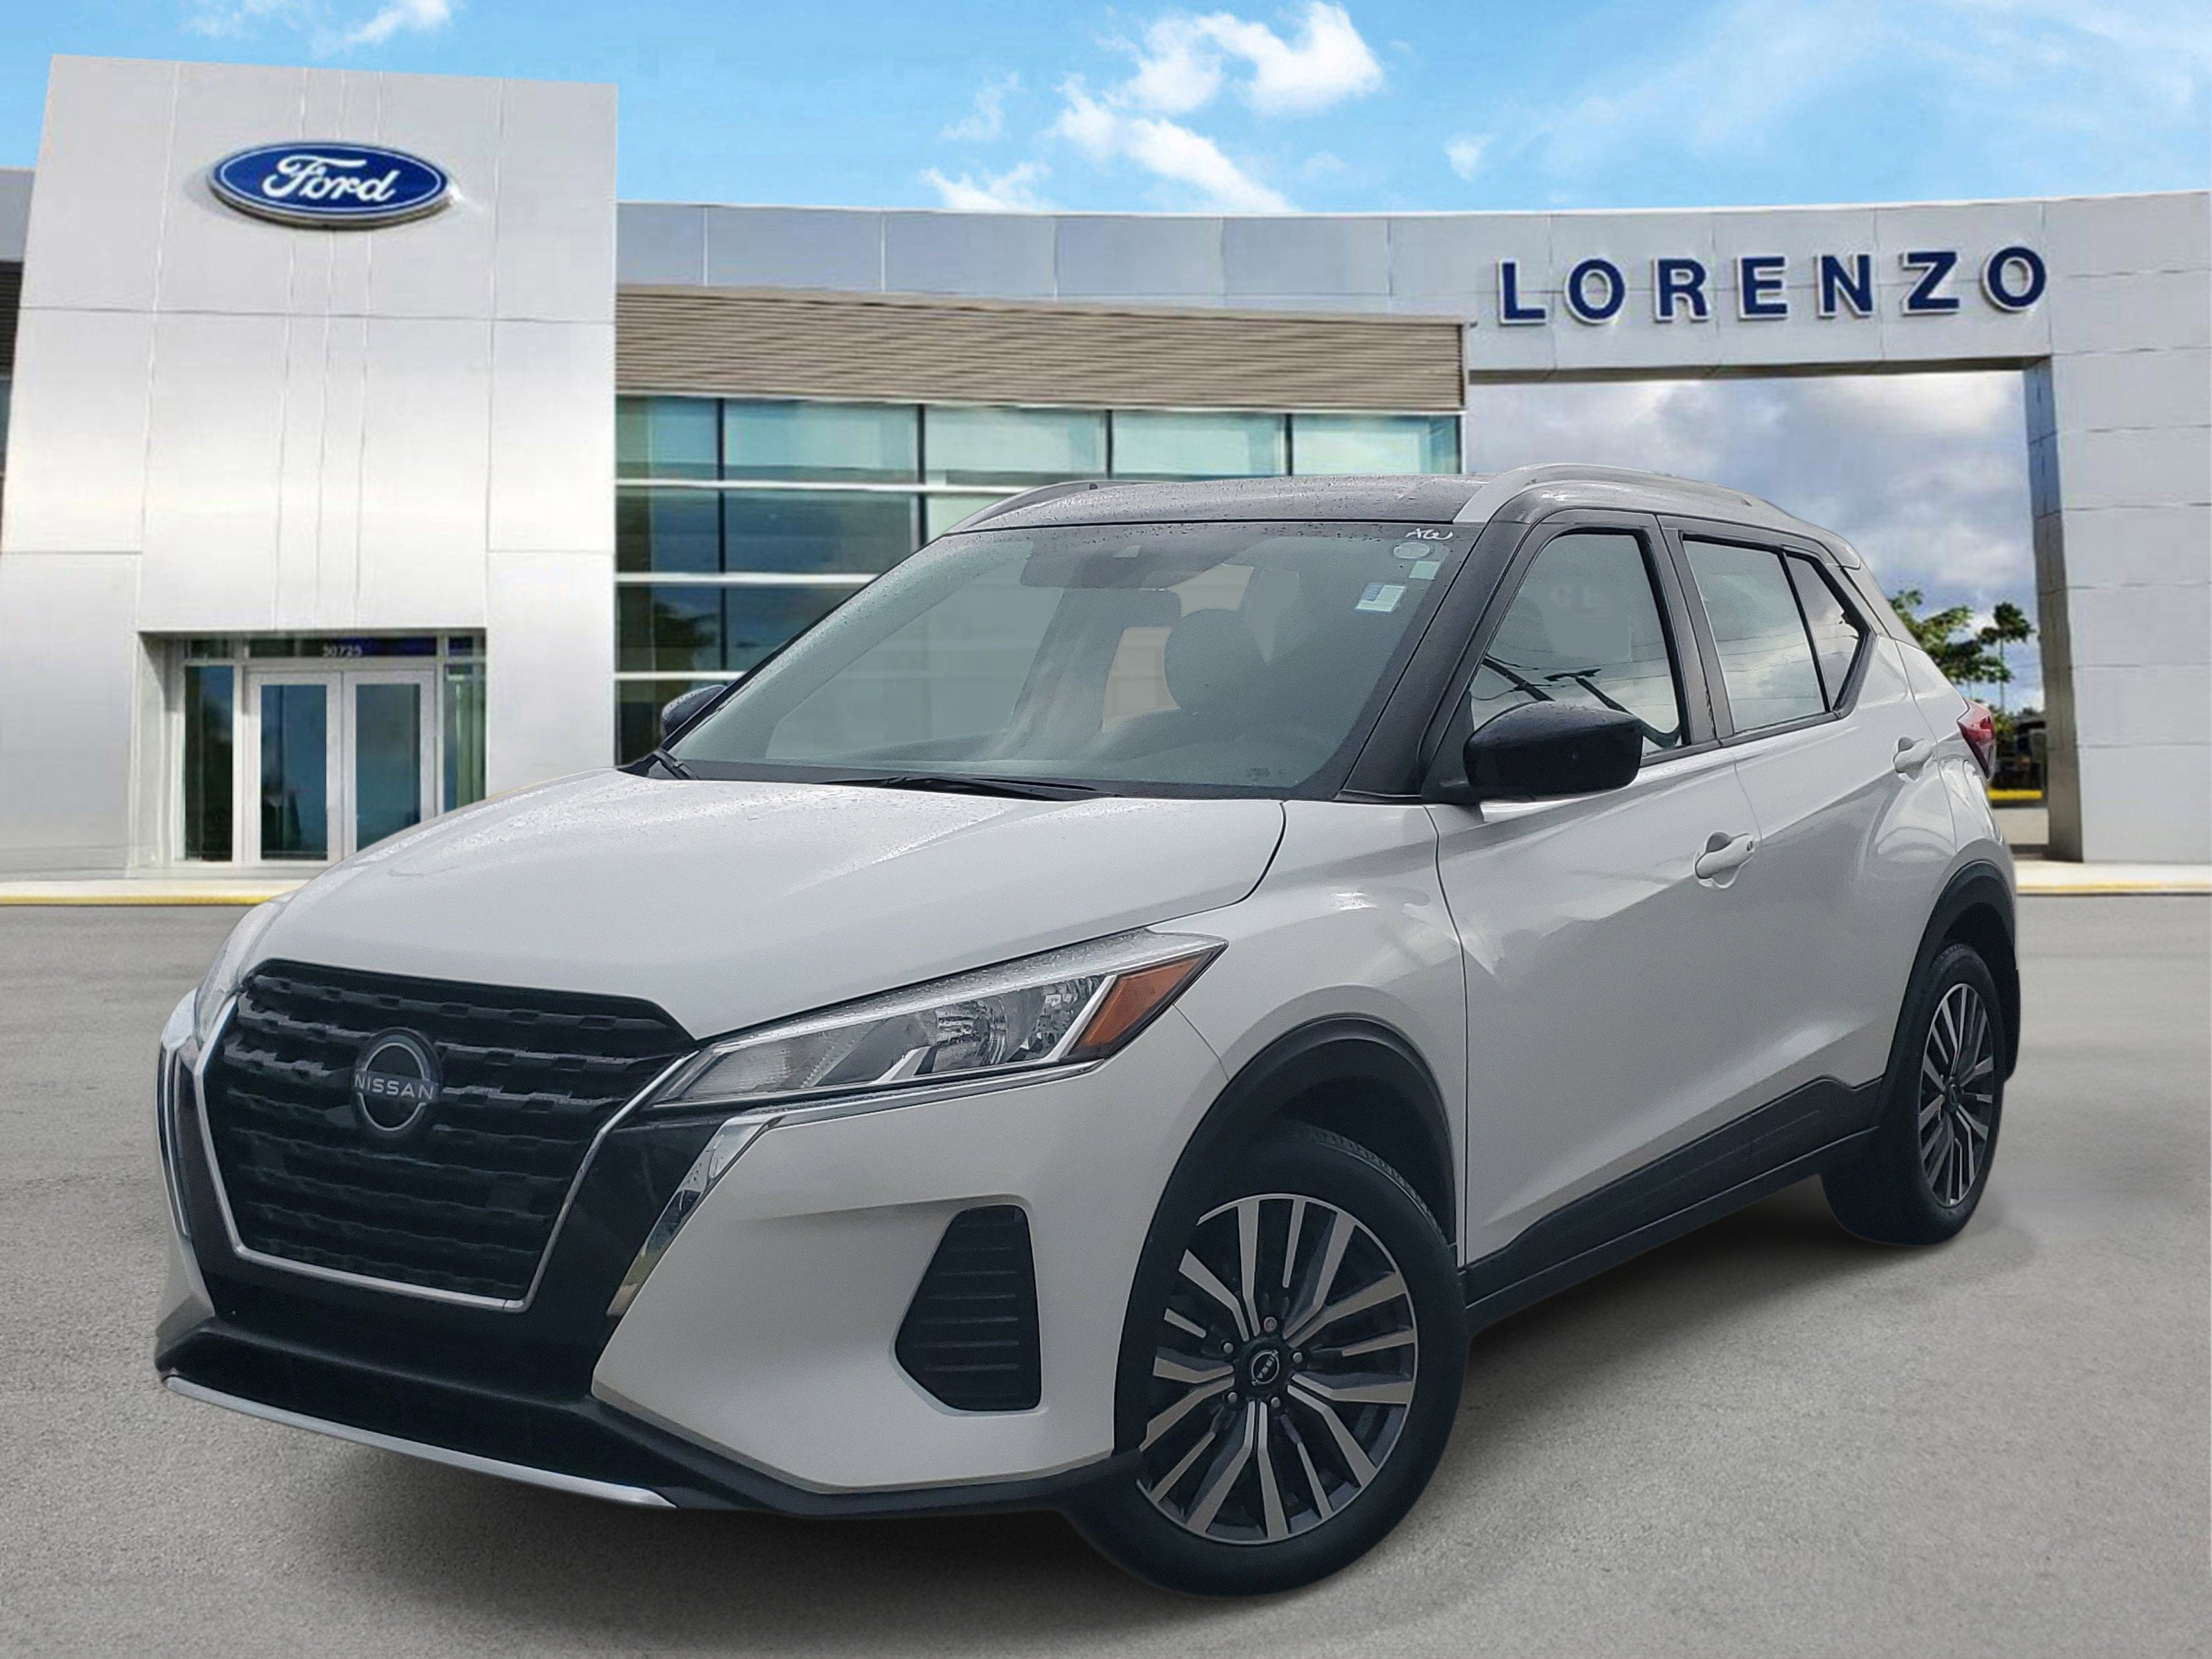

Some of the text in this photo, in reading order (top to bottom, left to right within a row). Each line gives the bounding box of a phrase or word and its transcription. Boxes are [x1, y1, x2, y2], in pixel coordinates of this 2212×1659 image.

[262, 155, 401, 202] Ford
[1497, 246, 2047, 325] LORENZO
[354, 1073, 434, 1100] NISSAN
